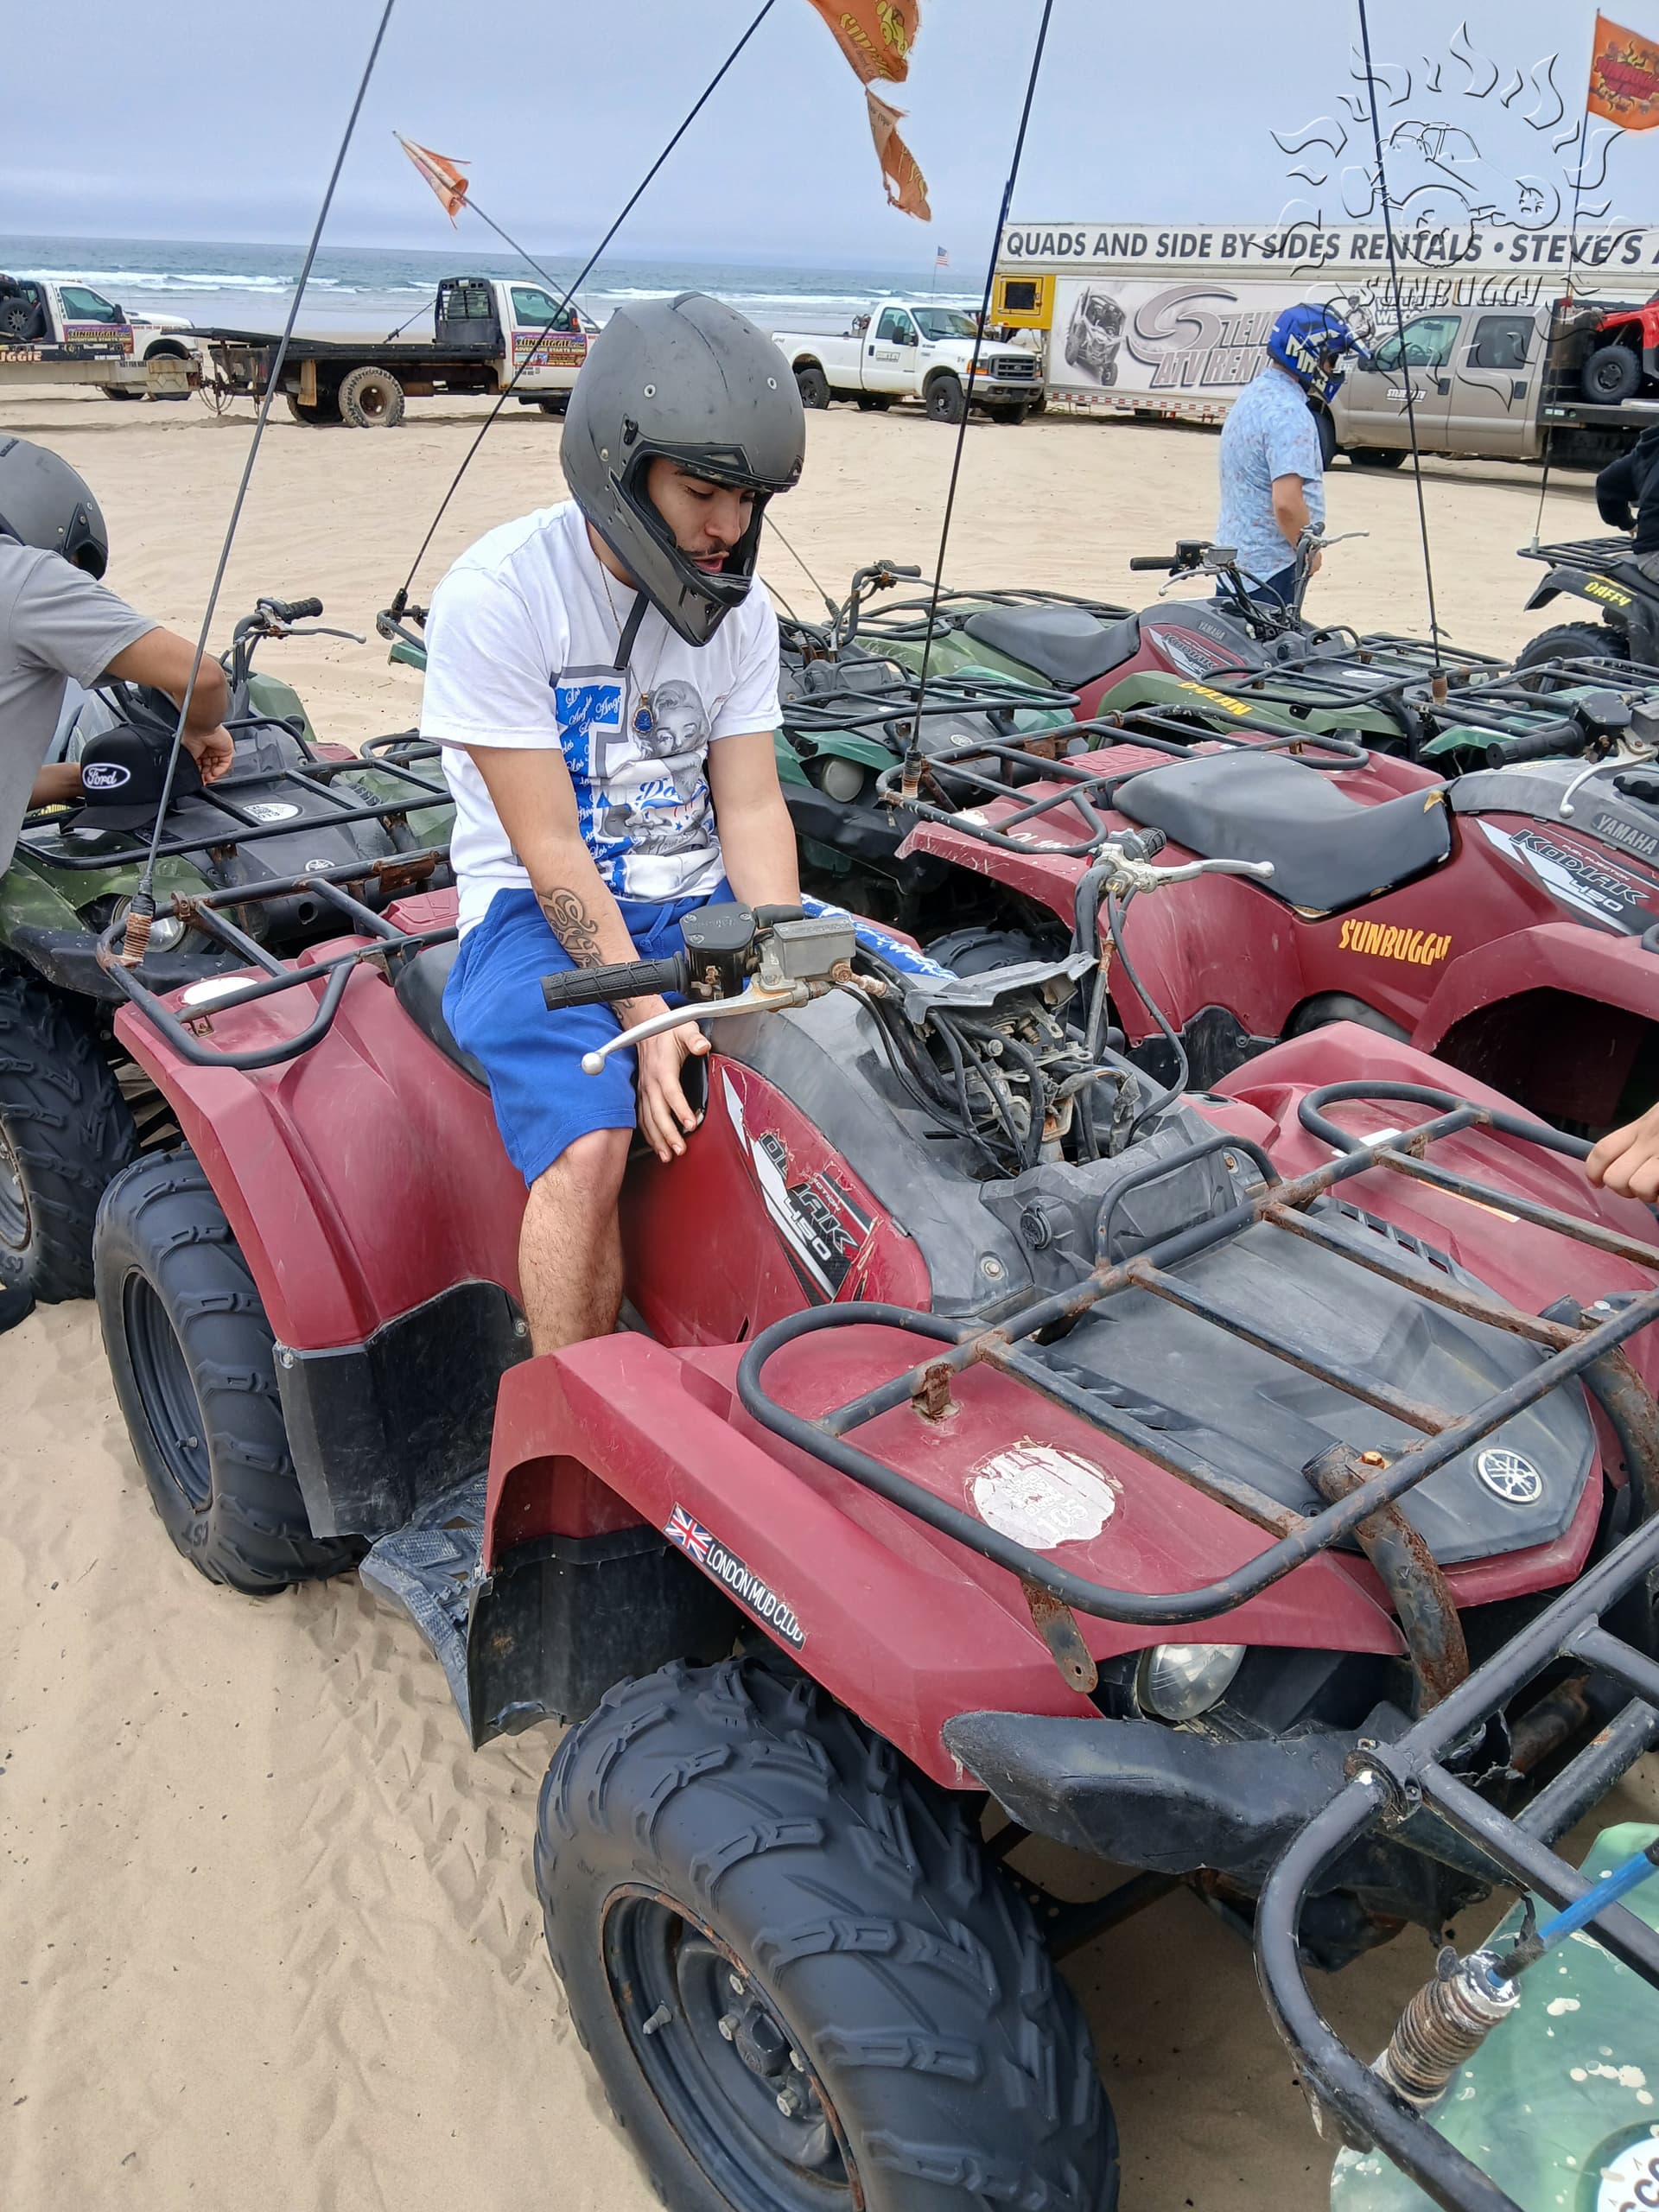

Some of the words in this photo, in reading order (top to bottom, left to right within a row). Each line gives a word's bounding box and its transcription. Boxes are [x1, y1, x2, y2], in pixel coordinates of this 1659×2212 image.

[1007, 232, 1086, 257] QUADS
[1092, 232, 1148, 257] AND
[1155, 232, 1212, 257] SIDE
[1221, 233, 1256, 258] BY
[1262, 233, 1340, 259] SIDES
[1350, 233, 1483, 261] RENTALS
[1509, 233, 1643, 264] STEVE'S
[1584, 582, 1632, 607] DAFFY
[1198, 621, 1226, 641] YAMAHA
[87, 766, 118, 785] Ford
[1597, 814, 1659, 857] YAMAHA
[1509, 828, 1650, 906] KODIAK
[1569, 878, 1624, 912] 450
[758, 1197, 832, 1262] 450
[706, 1543, 753, 1599] LONDON
[747, 1580, 777, 1618] MUD
